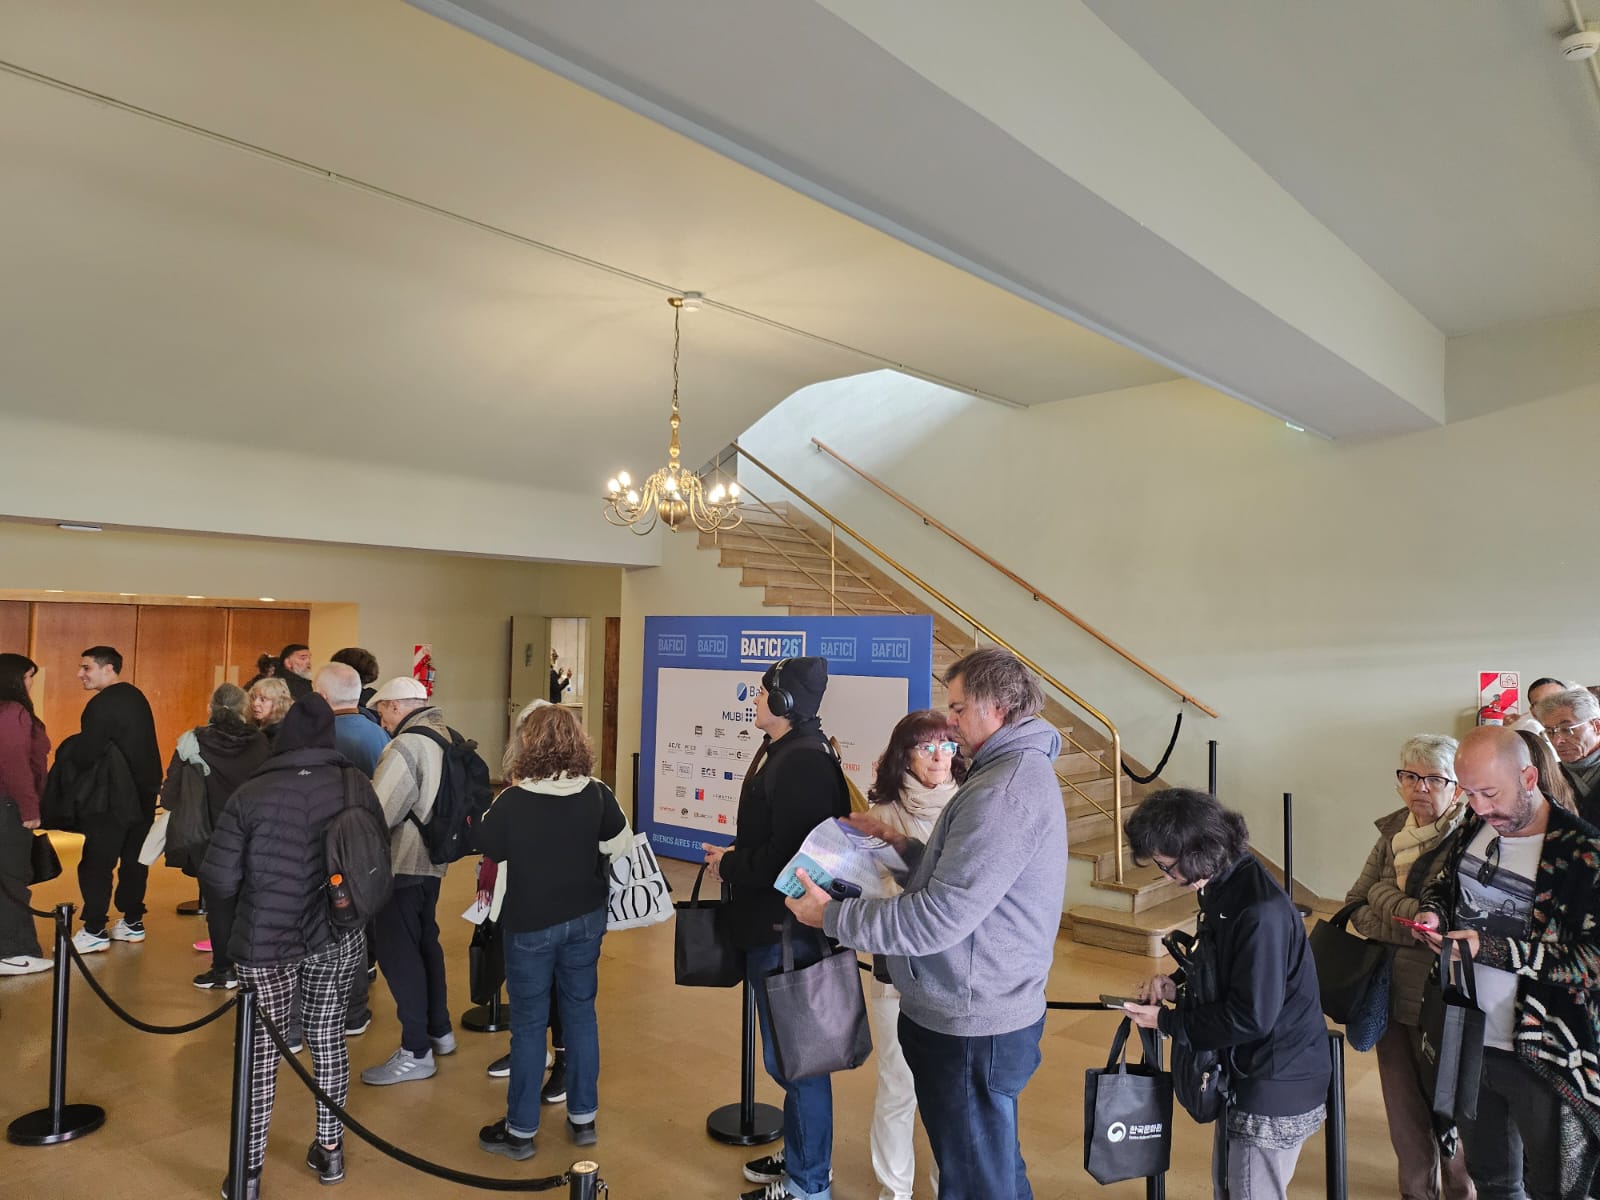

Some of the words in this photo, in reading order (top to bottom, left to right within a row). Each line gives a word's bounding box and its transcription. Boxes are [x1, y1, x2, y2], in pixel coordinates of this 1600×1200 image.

[658, 638, 684, 652] BAFICI
[697, 639, 725, 653] BAFICI
[820, 641, 853, 657] BAFICI
[871, 642, 907, 658] BAFICI
[722, 710, 744, 722] MUBI
[652, 833, 674, 845] BUENOS
[674, 837, 691, 848] AIRES
